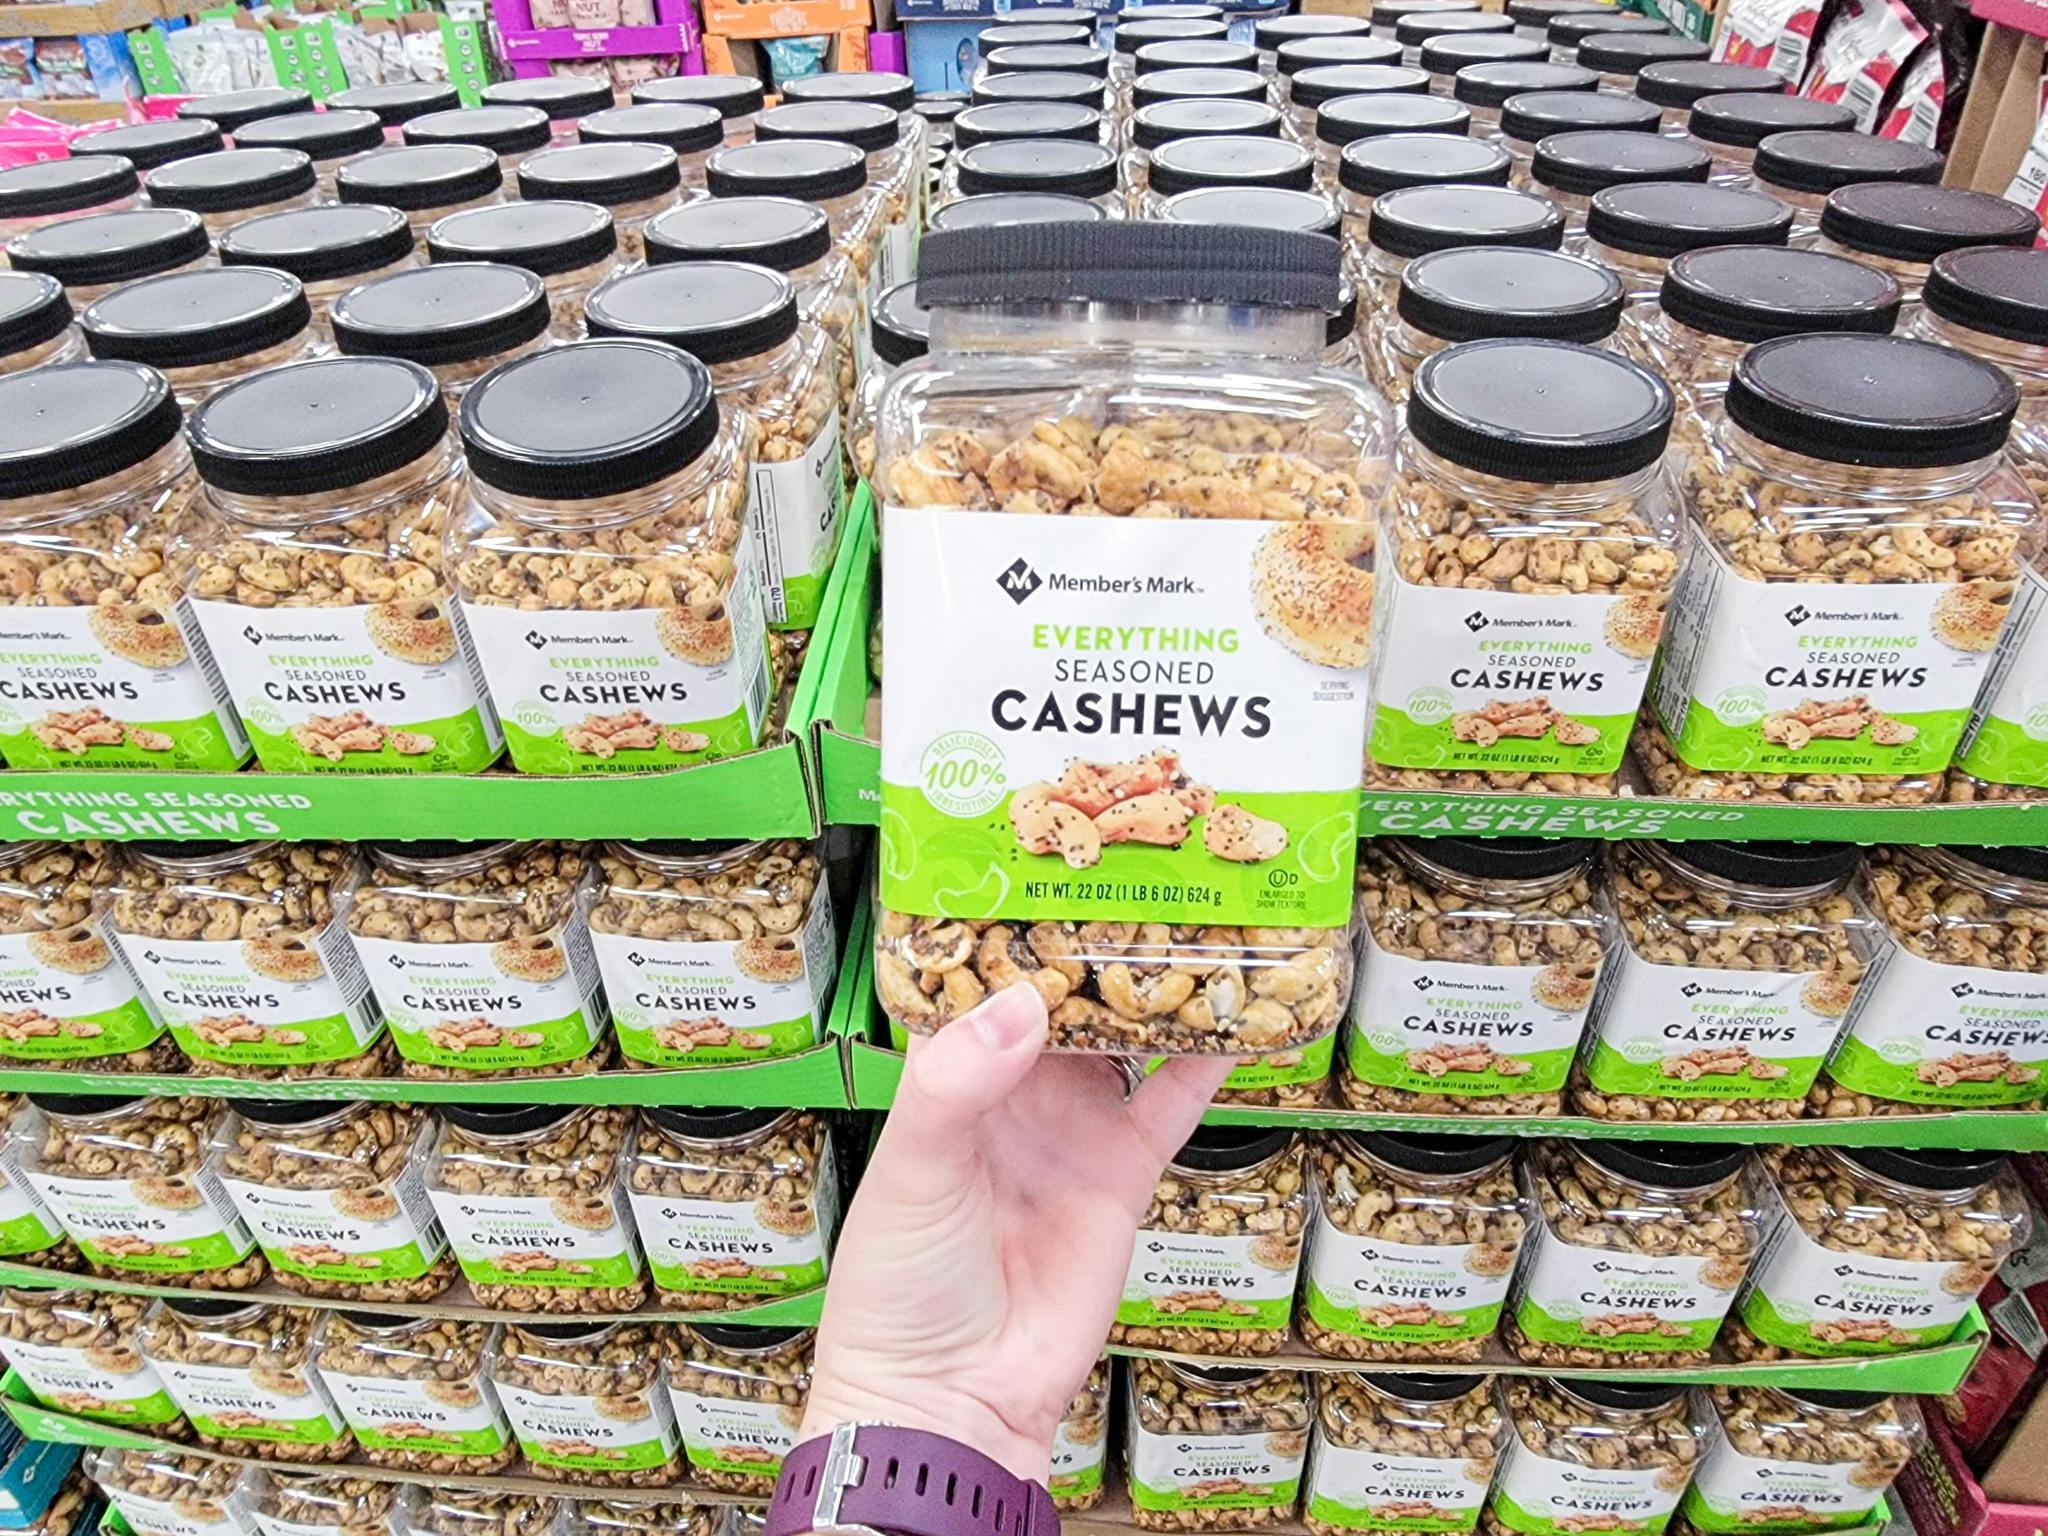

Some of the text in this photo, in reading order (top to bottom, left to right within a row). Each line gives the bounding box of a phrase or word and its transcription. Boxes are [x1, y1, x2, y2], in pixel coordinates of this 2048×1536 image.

[1049, 573, 1142, 593] Member's
[1032, 624, 1239, 653] EVERYTHING
[1798, 635, 1919, 649] EVERYTHING
[1479, 641, 1593, 654] EVERYTHING
[268, 655, 373, 666] EVERYTHING
[550, 656, 660, 668] EVERYTHING
[1488, 655, 1575, 668] SEASONED
[1807, 651, 1900, 665] SEASONED
[285, 670, 366, 681] SEASONED
[566, 671, 650, 682] SEASONED
[1054, 659, 1214, 684] SEASONED
[1765, 667, 1928, 689] CASHEWS
[1451, 669, 1604, 692] CASHEWS
[0, 681, 139, 699] CASHEWS
[265, 682, 405, 703] CASHEWS
[540, 683, 687, 703] CASHEWS
[991, 688, 1271, 738] CASHEWS
[925, 759, 1006, 789] 100%
[143, 793, 312, 809] SEASONED
[1560, 805, 1745, 822] SEASONED
[17, 811, 280, 835] CASHEWS
[1380, 814, 1667, 833] CASHEWS
[1026, 882, 1221, 907] NET WT. 22 OZ (1 LB 6 OZ) 624 g
[163, 990, 280, 1009] CASHEWS
[403, 995, 522, 1012] CASHEWS
[636, 993, 756, 1011] CASHEWS
[1435, 1009, 1510, 1020] SEASONED
[1698, 1015, 1774, 1025] SEASONED
[1403, 1016, 1534, 1037] CASHEWS
[1664, 1024, 1796, 1041] CASHEWS
[66, 1213, 166, 1230] CASHEWS
[261, 1221, 360, 1241] CASHEWS
[471, 1233, 576, 1248] CASHEWS
[668, 1238, 773, 1254] CASHEWS
[1144, 1272, 1255, 1288] CASHEWS
[1354, 1279, 1467, 1299] CASHEWS
[1580, 1292, 1697, 1309] CASHEWS
[1814, 1294, 1934, 1316] CASHEWS
[357, 1407, 447, 1421] CASHEWS
[523, 1420, 613, 1437] CASHEWS
[700, 1427, 792, 1446] CASHEWS
[1173, 1465, 1271, 1477] CASHEWS
[1365, 1486, 1465, 1499] CASHEWS
